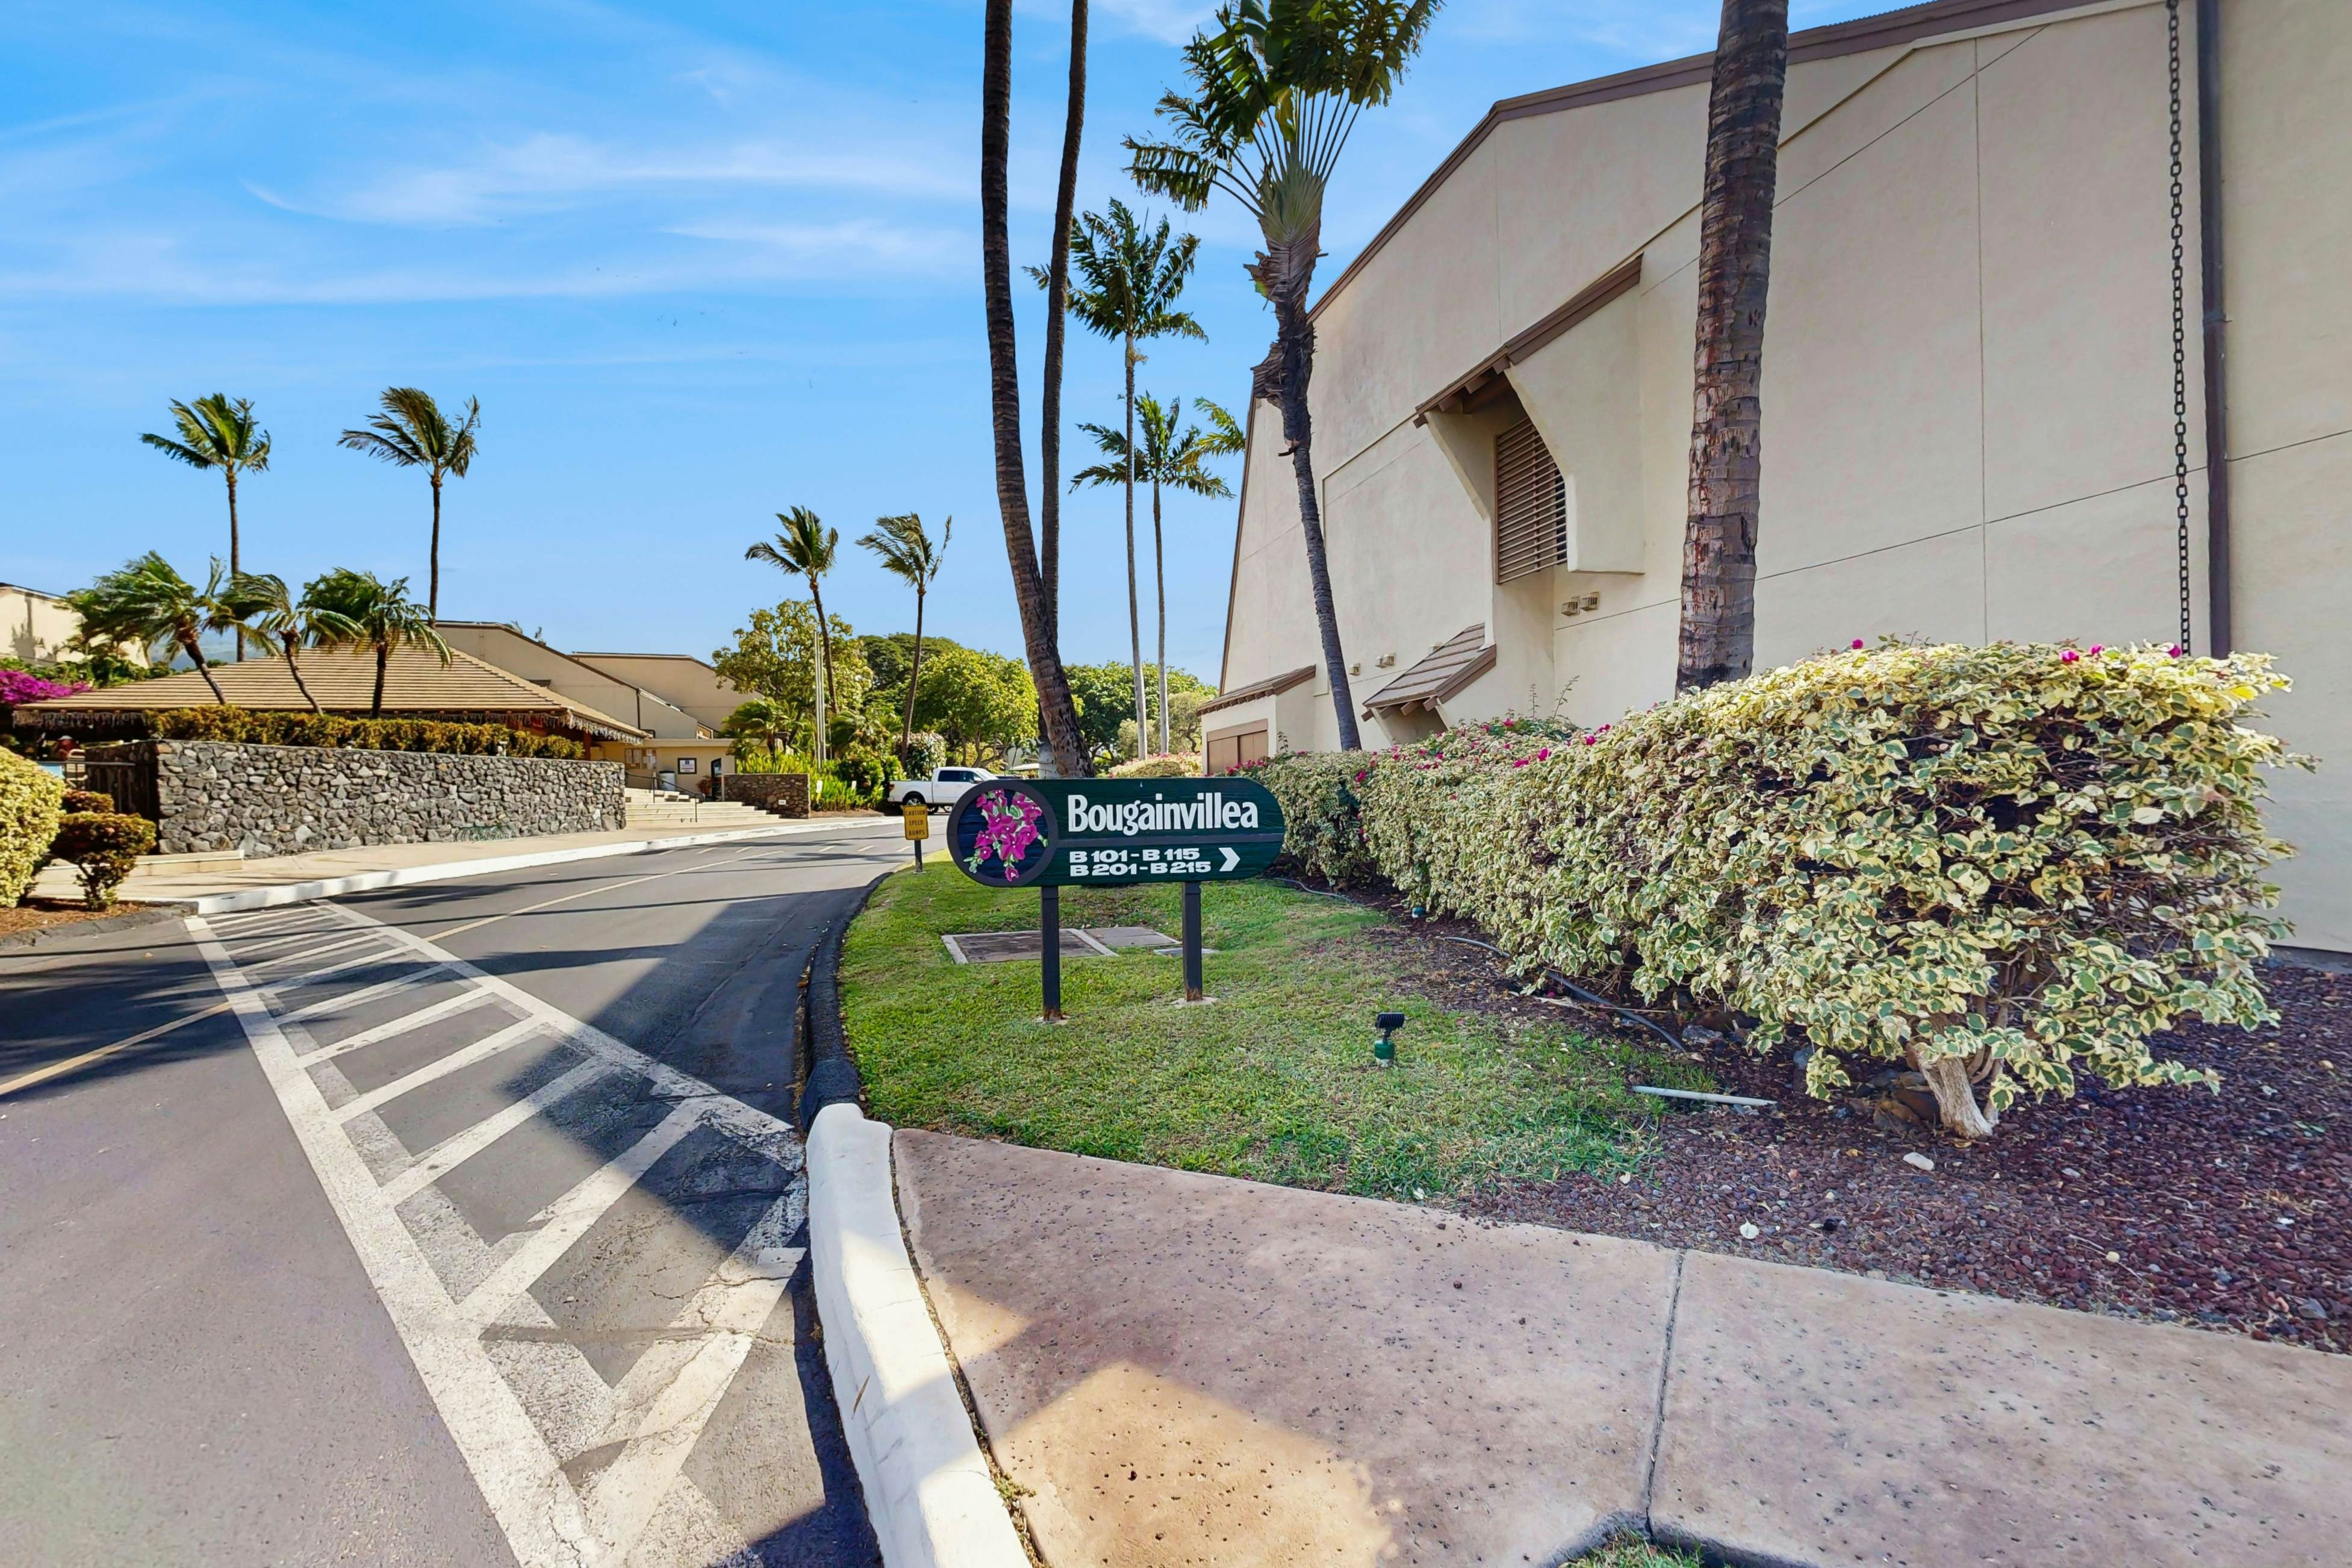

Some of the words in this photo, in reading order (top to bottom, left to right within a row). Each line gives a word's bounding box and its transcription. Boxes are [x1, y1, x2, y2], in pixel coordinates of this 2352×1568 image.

[1068, 792, 1258, 836] Bougainvillea
[1164, 848, 1200, 861] 115
[1170, 861, 1212, 873] 215
